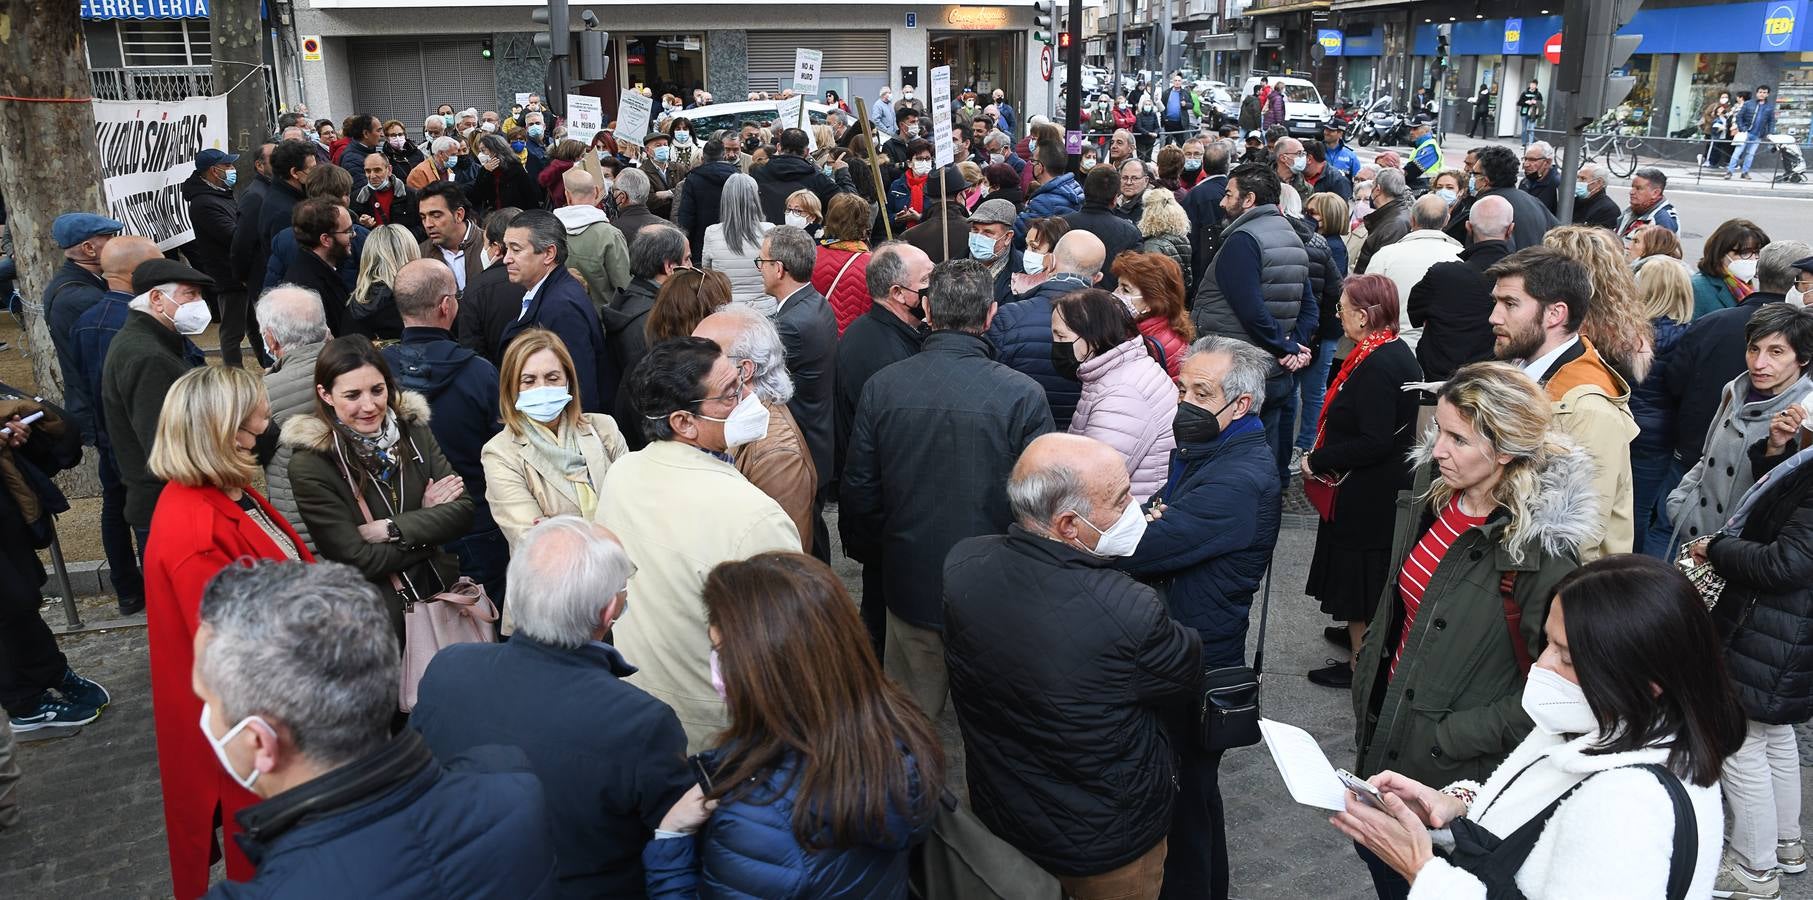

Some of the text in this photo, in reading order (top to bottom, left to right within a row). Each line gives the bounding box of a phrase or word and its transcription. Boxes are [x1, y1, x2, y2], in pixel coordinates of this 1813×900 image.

[1765, 17, 1795, 35] TEDi
[801, 62, 809, 70] NO
[800, 72, 813, 81] MURO
[572, 120, 596, 129] AL MURO
